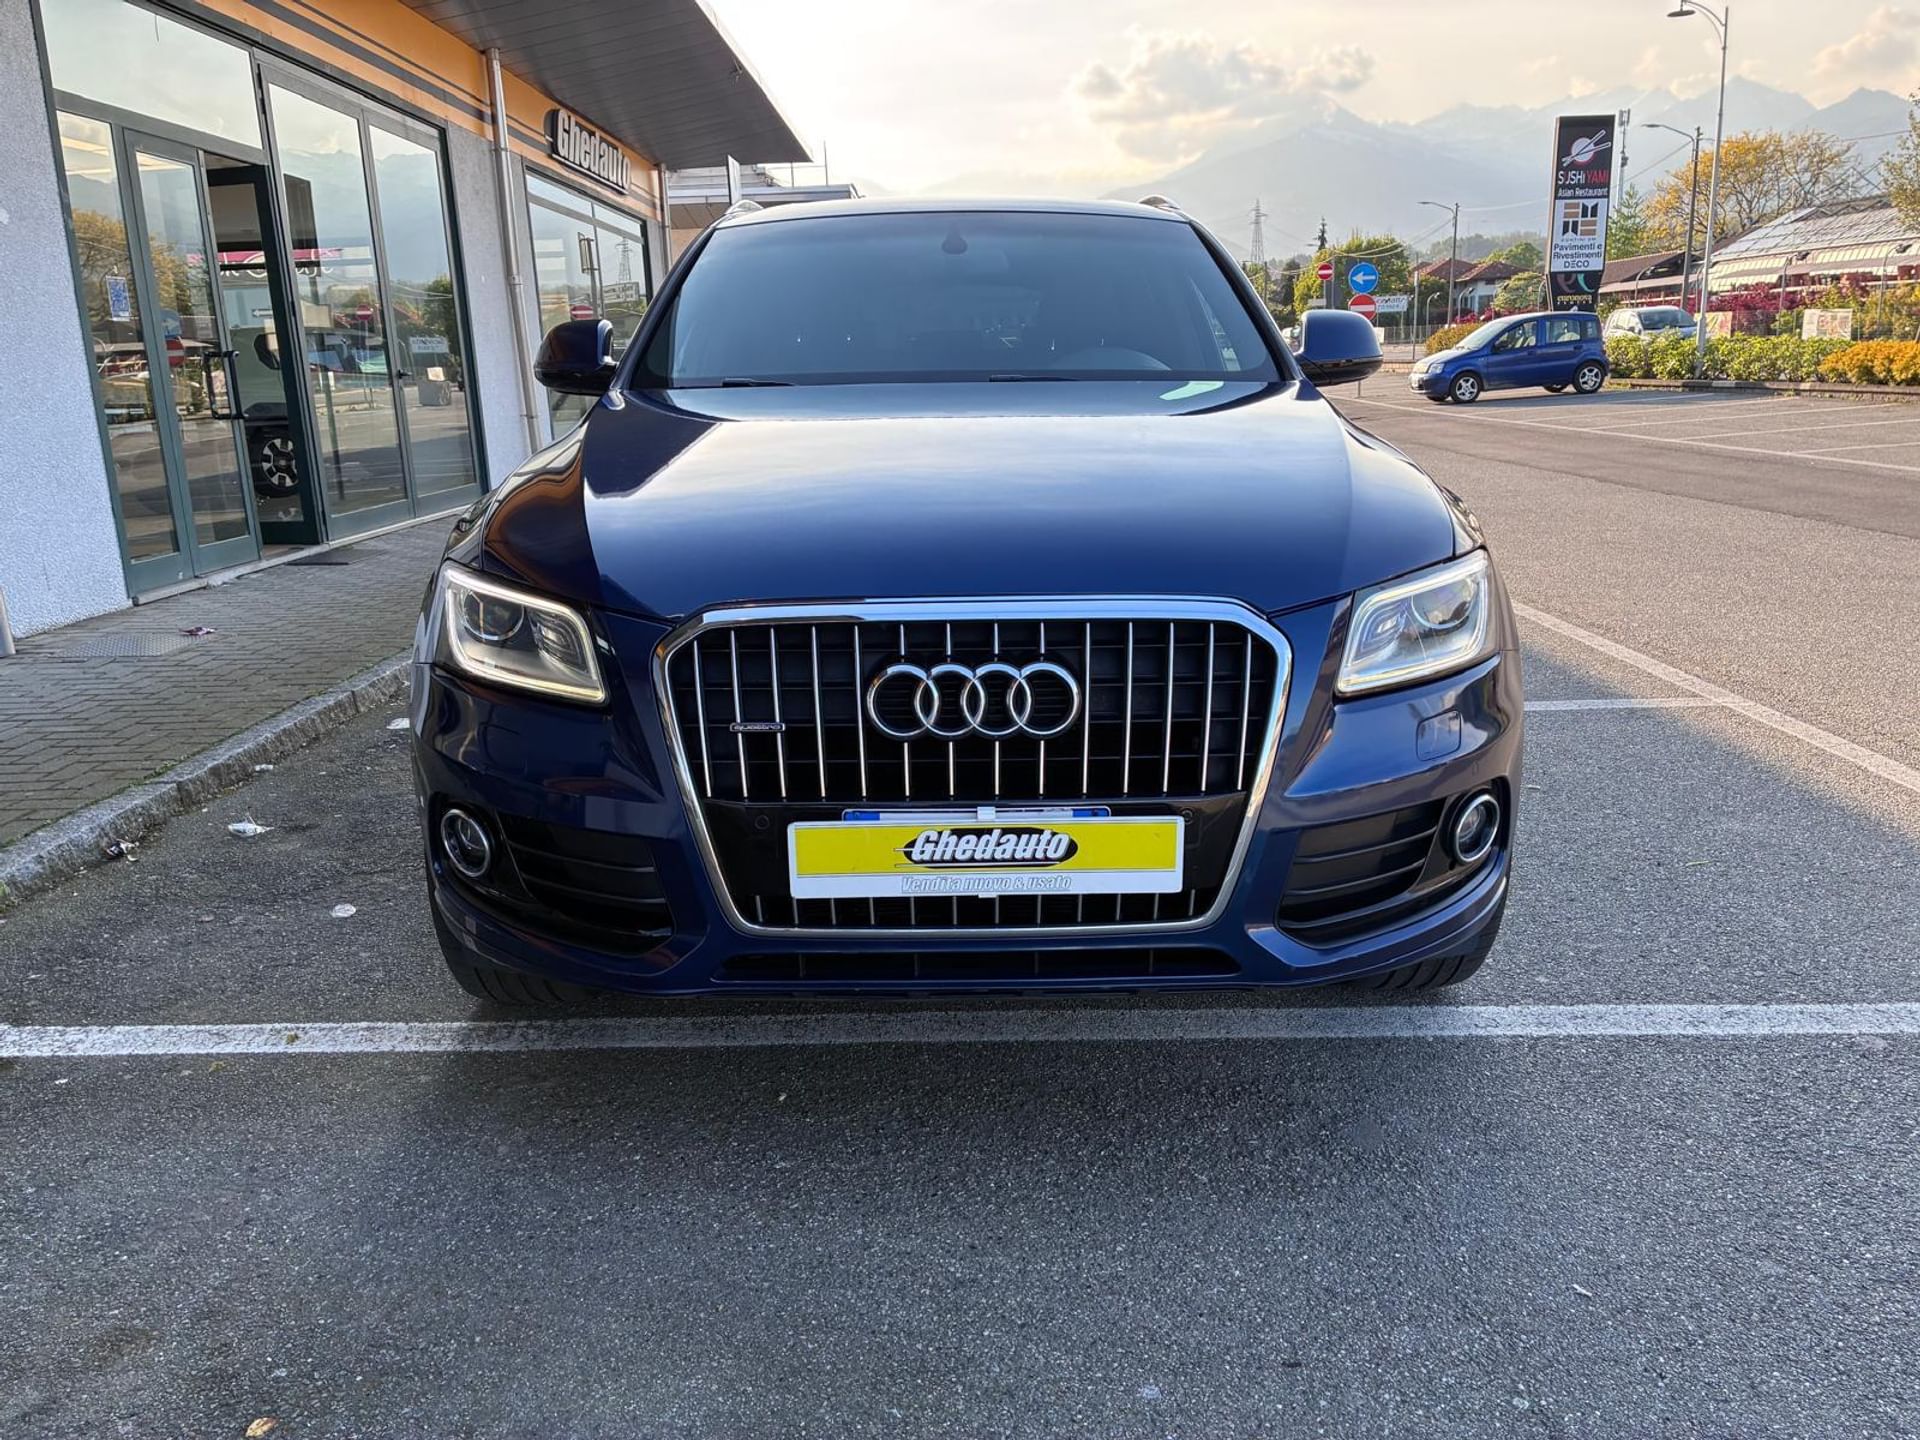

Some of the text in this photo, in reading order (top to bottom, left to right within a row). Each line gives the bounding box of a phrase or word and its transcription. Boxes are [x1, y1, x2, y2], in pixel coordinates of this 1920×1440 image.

[557, 109, 631, 190] Ghedauto
[1558, 187, 1608, 197] Asian Restaurant
[1553, 243, 1595, 252] Pavimenti
[1553, 251, 1602, 260] Rivestimenti
[1563, 260, 1590, 269] DECO
[911, 829, 1070, 862] Ghedauto
[902, 875, 1072, 893] Vendita nuovo & usato
